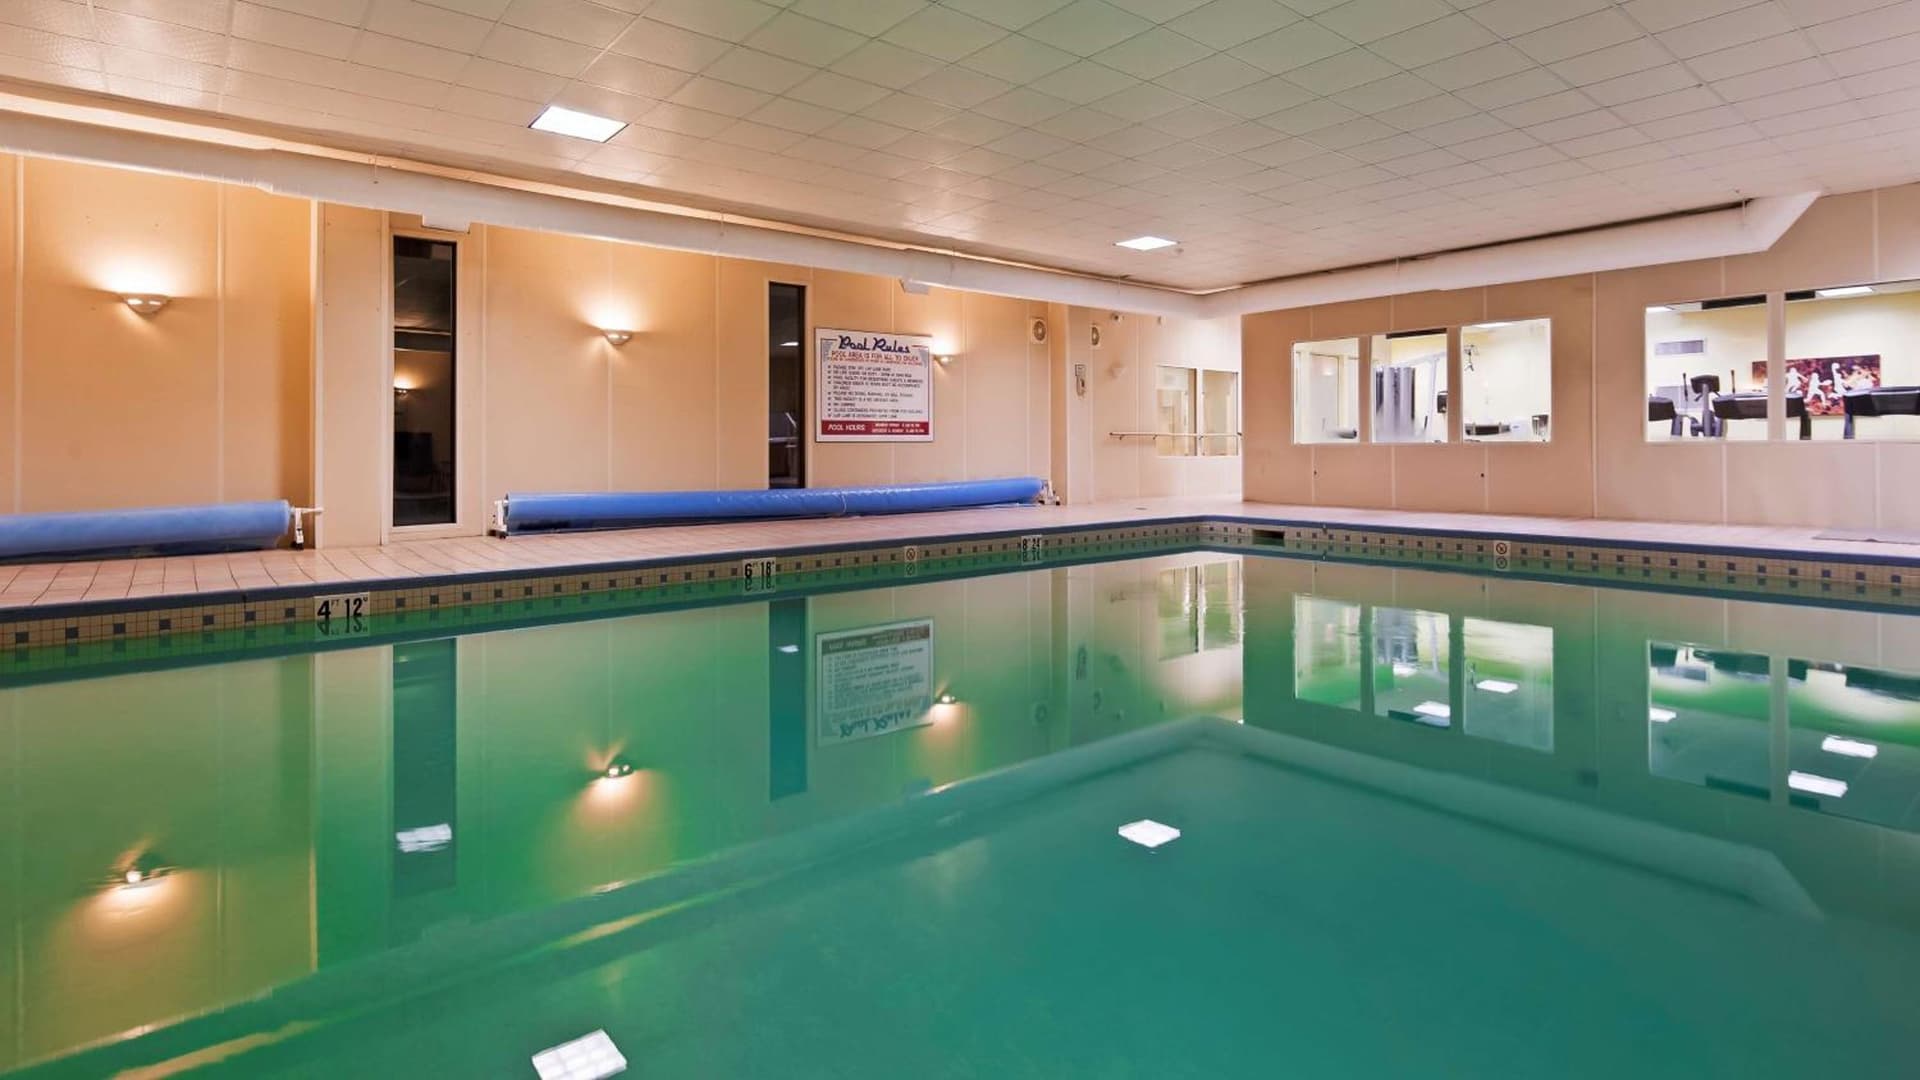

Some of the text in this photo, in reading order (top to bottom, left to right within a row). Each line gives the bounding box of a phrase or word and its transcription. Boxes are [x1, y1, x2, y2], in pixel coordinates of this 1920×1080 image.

[838, 335, 910, 353] Pool Rules
[827, 423, 844, 431] POOL
[1022, 537, 1040, 551] 8 24
[745, 563, 752, 578] 6
[761, 561, 771, 577] 18
[317, 600, 331, 618] 4
[345, 597, 362, 617] 12
